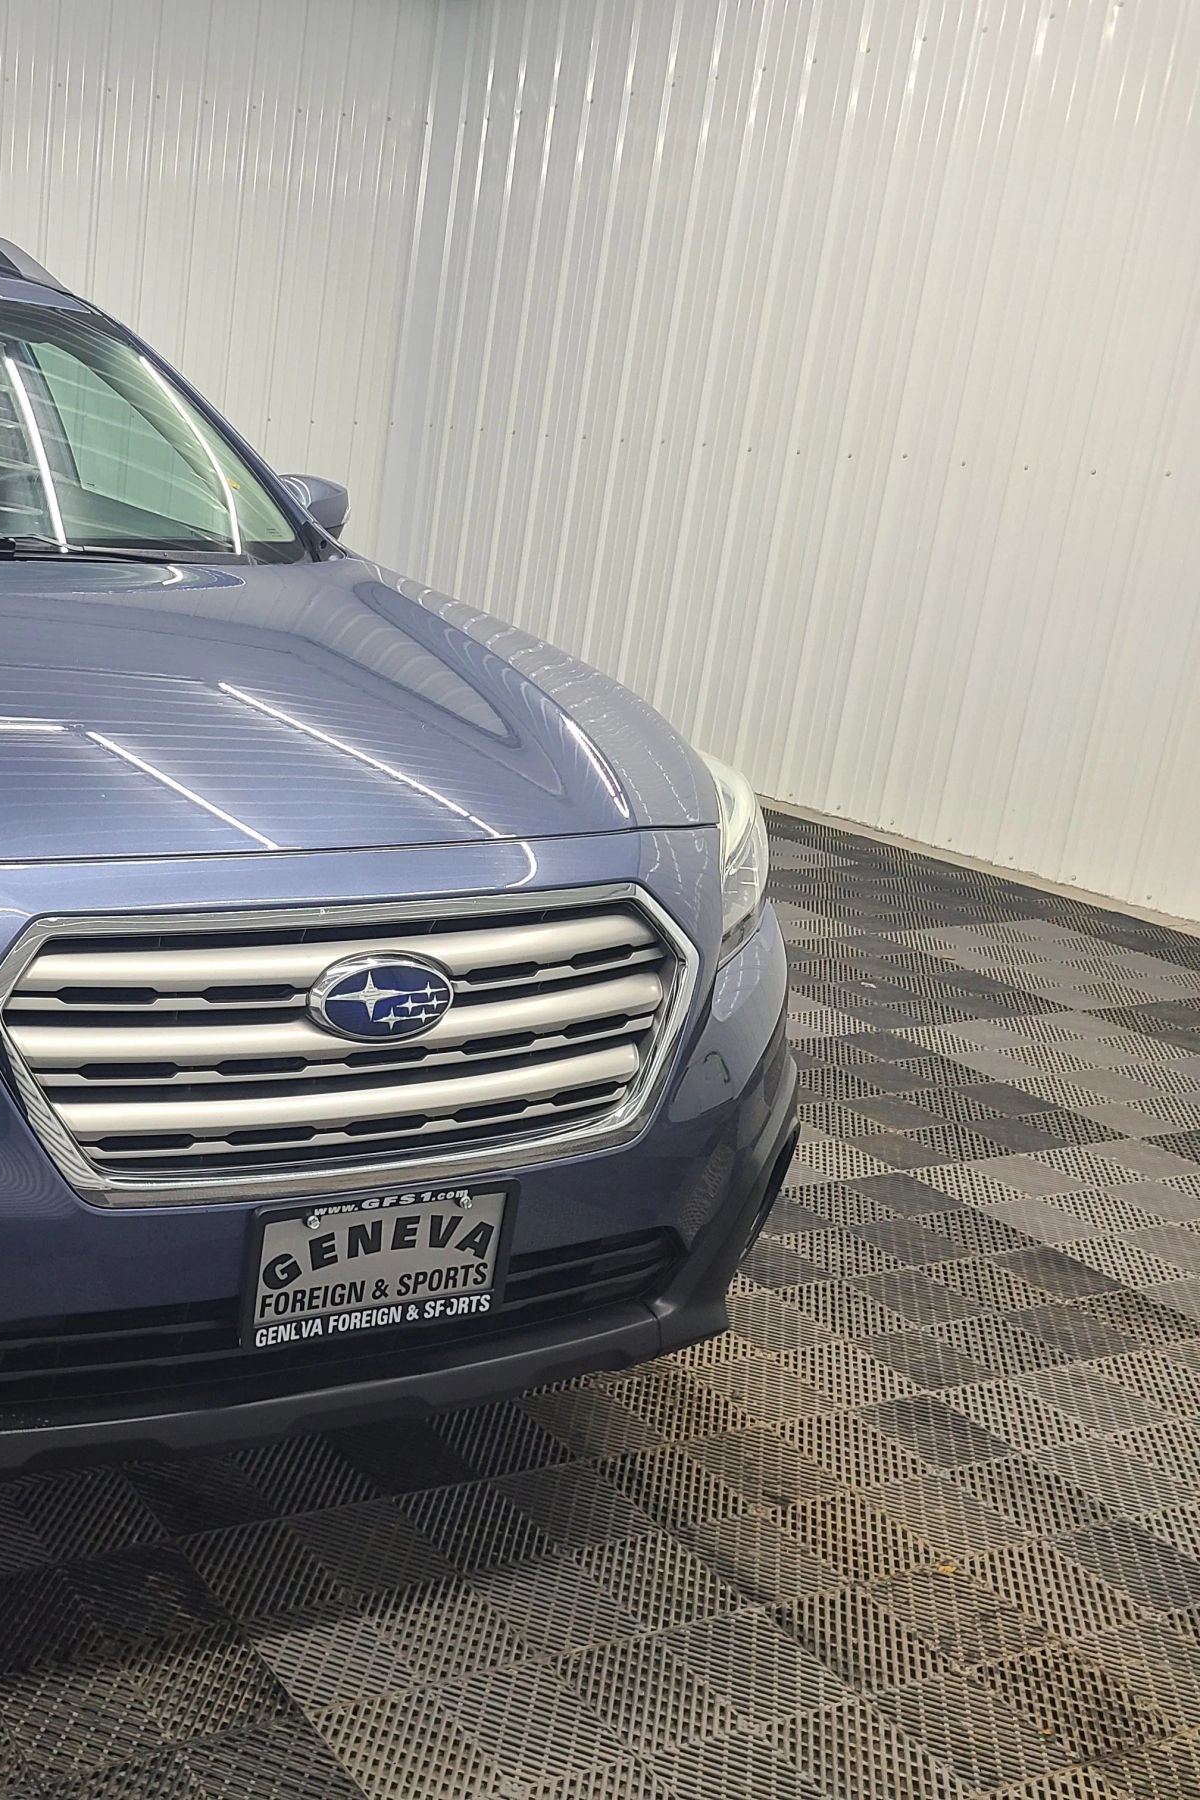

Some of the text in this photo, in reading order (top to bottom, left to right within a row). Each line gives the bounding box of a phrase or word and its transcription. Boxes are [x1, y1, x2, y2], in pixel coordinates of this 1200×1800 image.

[314, 1189, 469, 1216] www.GFS1.com
[262, 1215, 495, 1290] GENEVA
[259, 1262, 488, 1318] FOREIGN & SPORTS
[328, 1306, 402, 1334] FOREIGN
[406, 1304, 420, 1321] &
